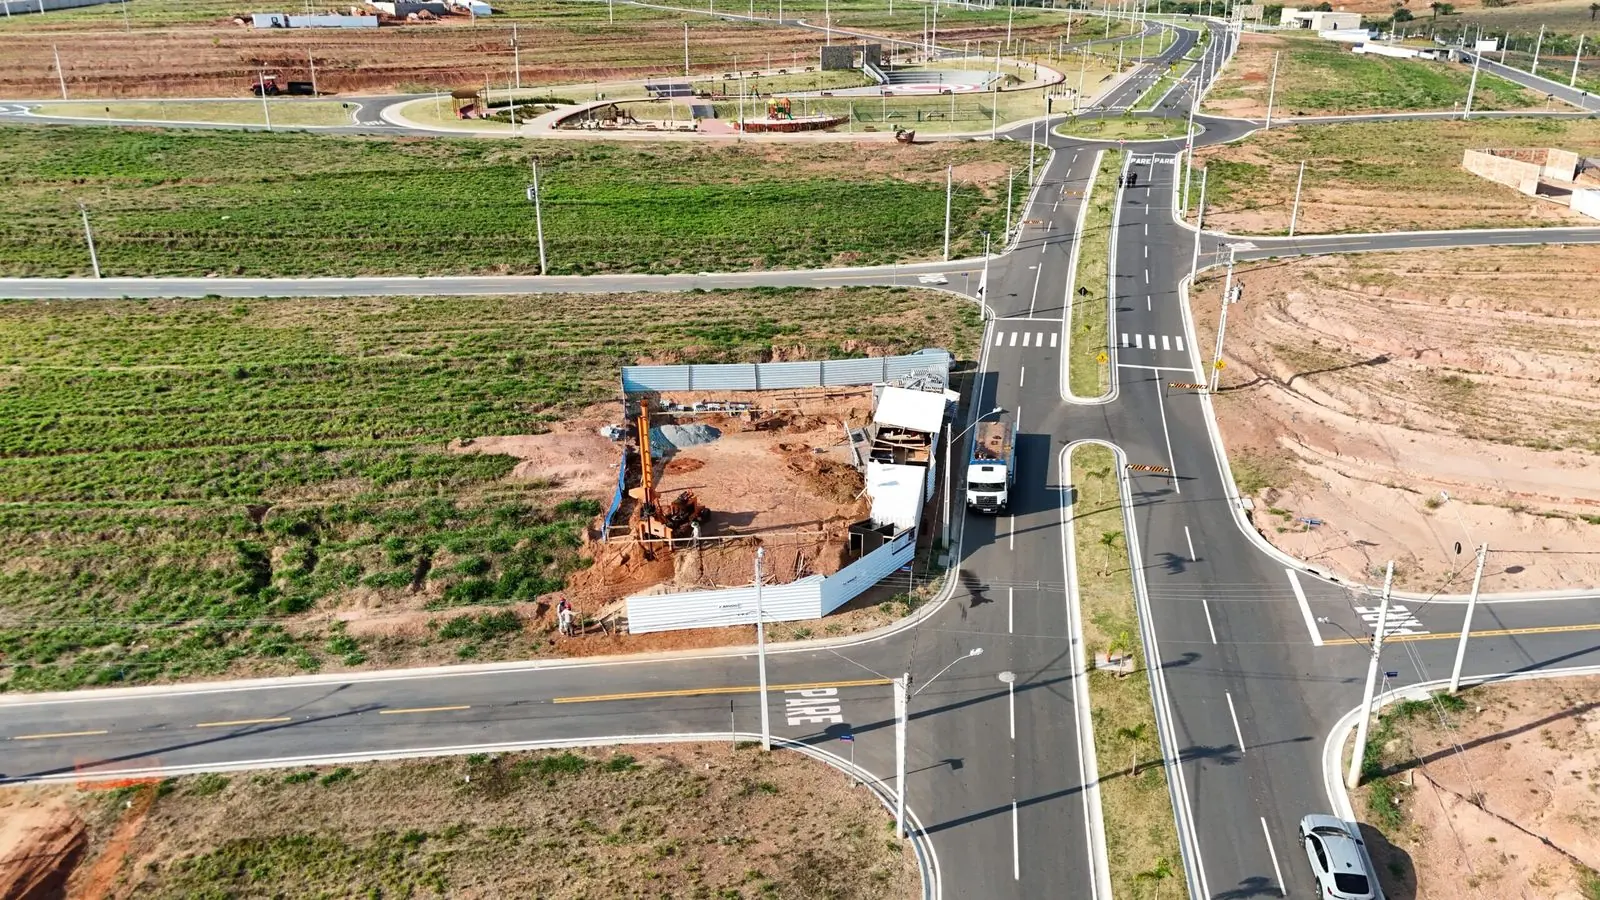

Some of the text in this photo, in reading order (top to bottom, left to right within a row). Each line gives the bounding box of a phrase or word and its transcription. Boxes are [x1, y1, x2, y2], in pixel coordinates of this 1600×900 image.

[1130, 157, 1151, 165] PARE
[1154, 157, 1175, 165] PARE
[784, 687, 843, 726] PARE
